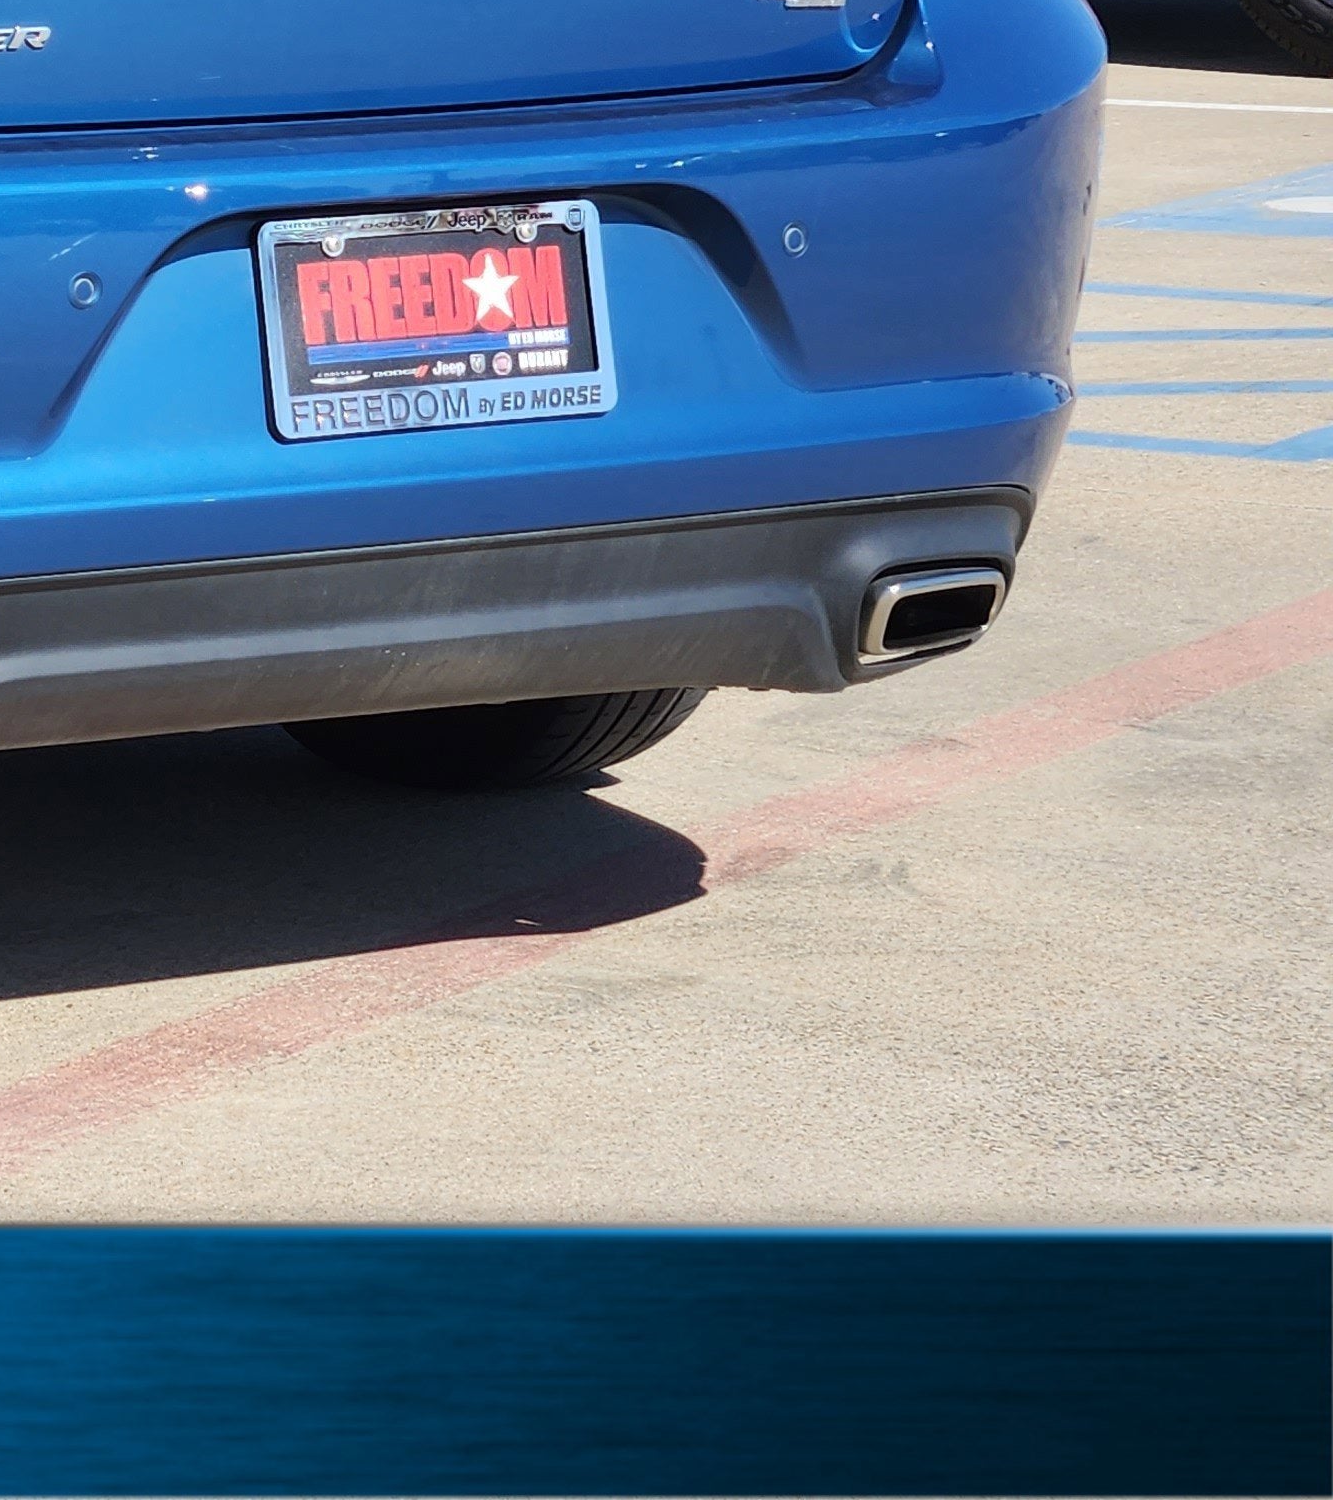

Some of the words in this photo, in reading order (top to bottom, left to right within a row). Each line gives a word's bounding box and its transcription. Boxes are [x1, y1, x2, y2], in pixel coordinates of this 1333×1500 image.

[448, 209, 486, 229] Jeep
[296, 245, 568, 346] FREEDOM
[432, 360, 466, 376] Jeep
[291, 388, 471, 433] FREEDOM
[501, 390, 526, 412] ED
[532, 384, 601, 411] MORSE
